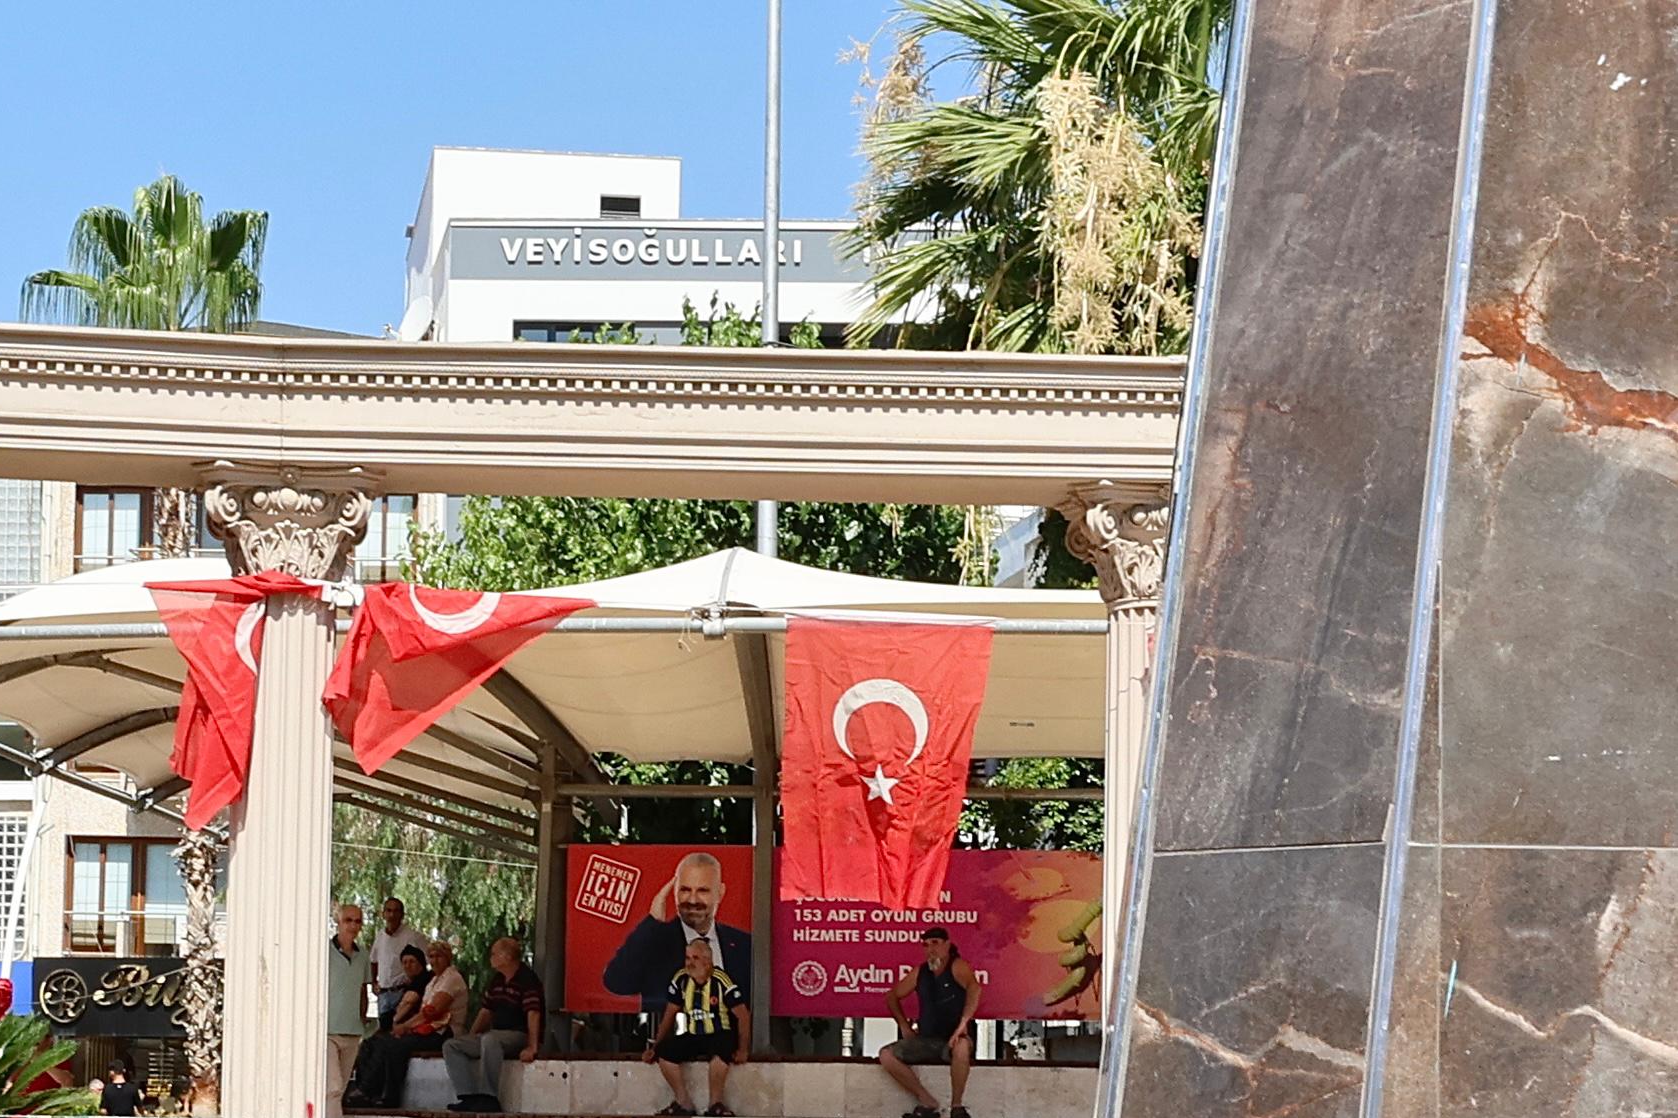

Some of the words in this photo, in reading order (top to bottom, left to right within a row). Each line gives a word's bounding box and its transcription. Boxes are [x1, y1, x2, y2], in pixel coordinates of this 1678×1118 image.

[592, 861, 634, 882] MENEMEN
[585, 870, 631, 903] İÇİN
[581, 892, 598, 908] EN
[794, 908, 822, 922] 153
[826, 909, 866, 923] ADET
[870, 909, 917, 923] OYUN
[921, 910, 978, 923] GRUBU
[793, 926, 860, 942] HİZMETE
[834, 963, 893, 988] Aydın
